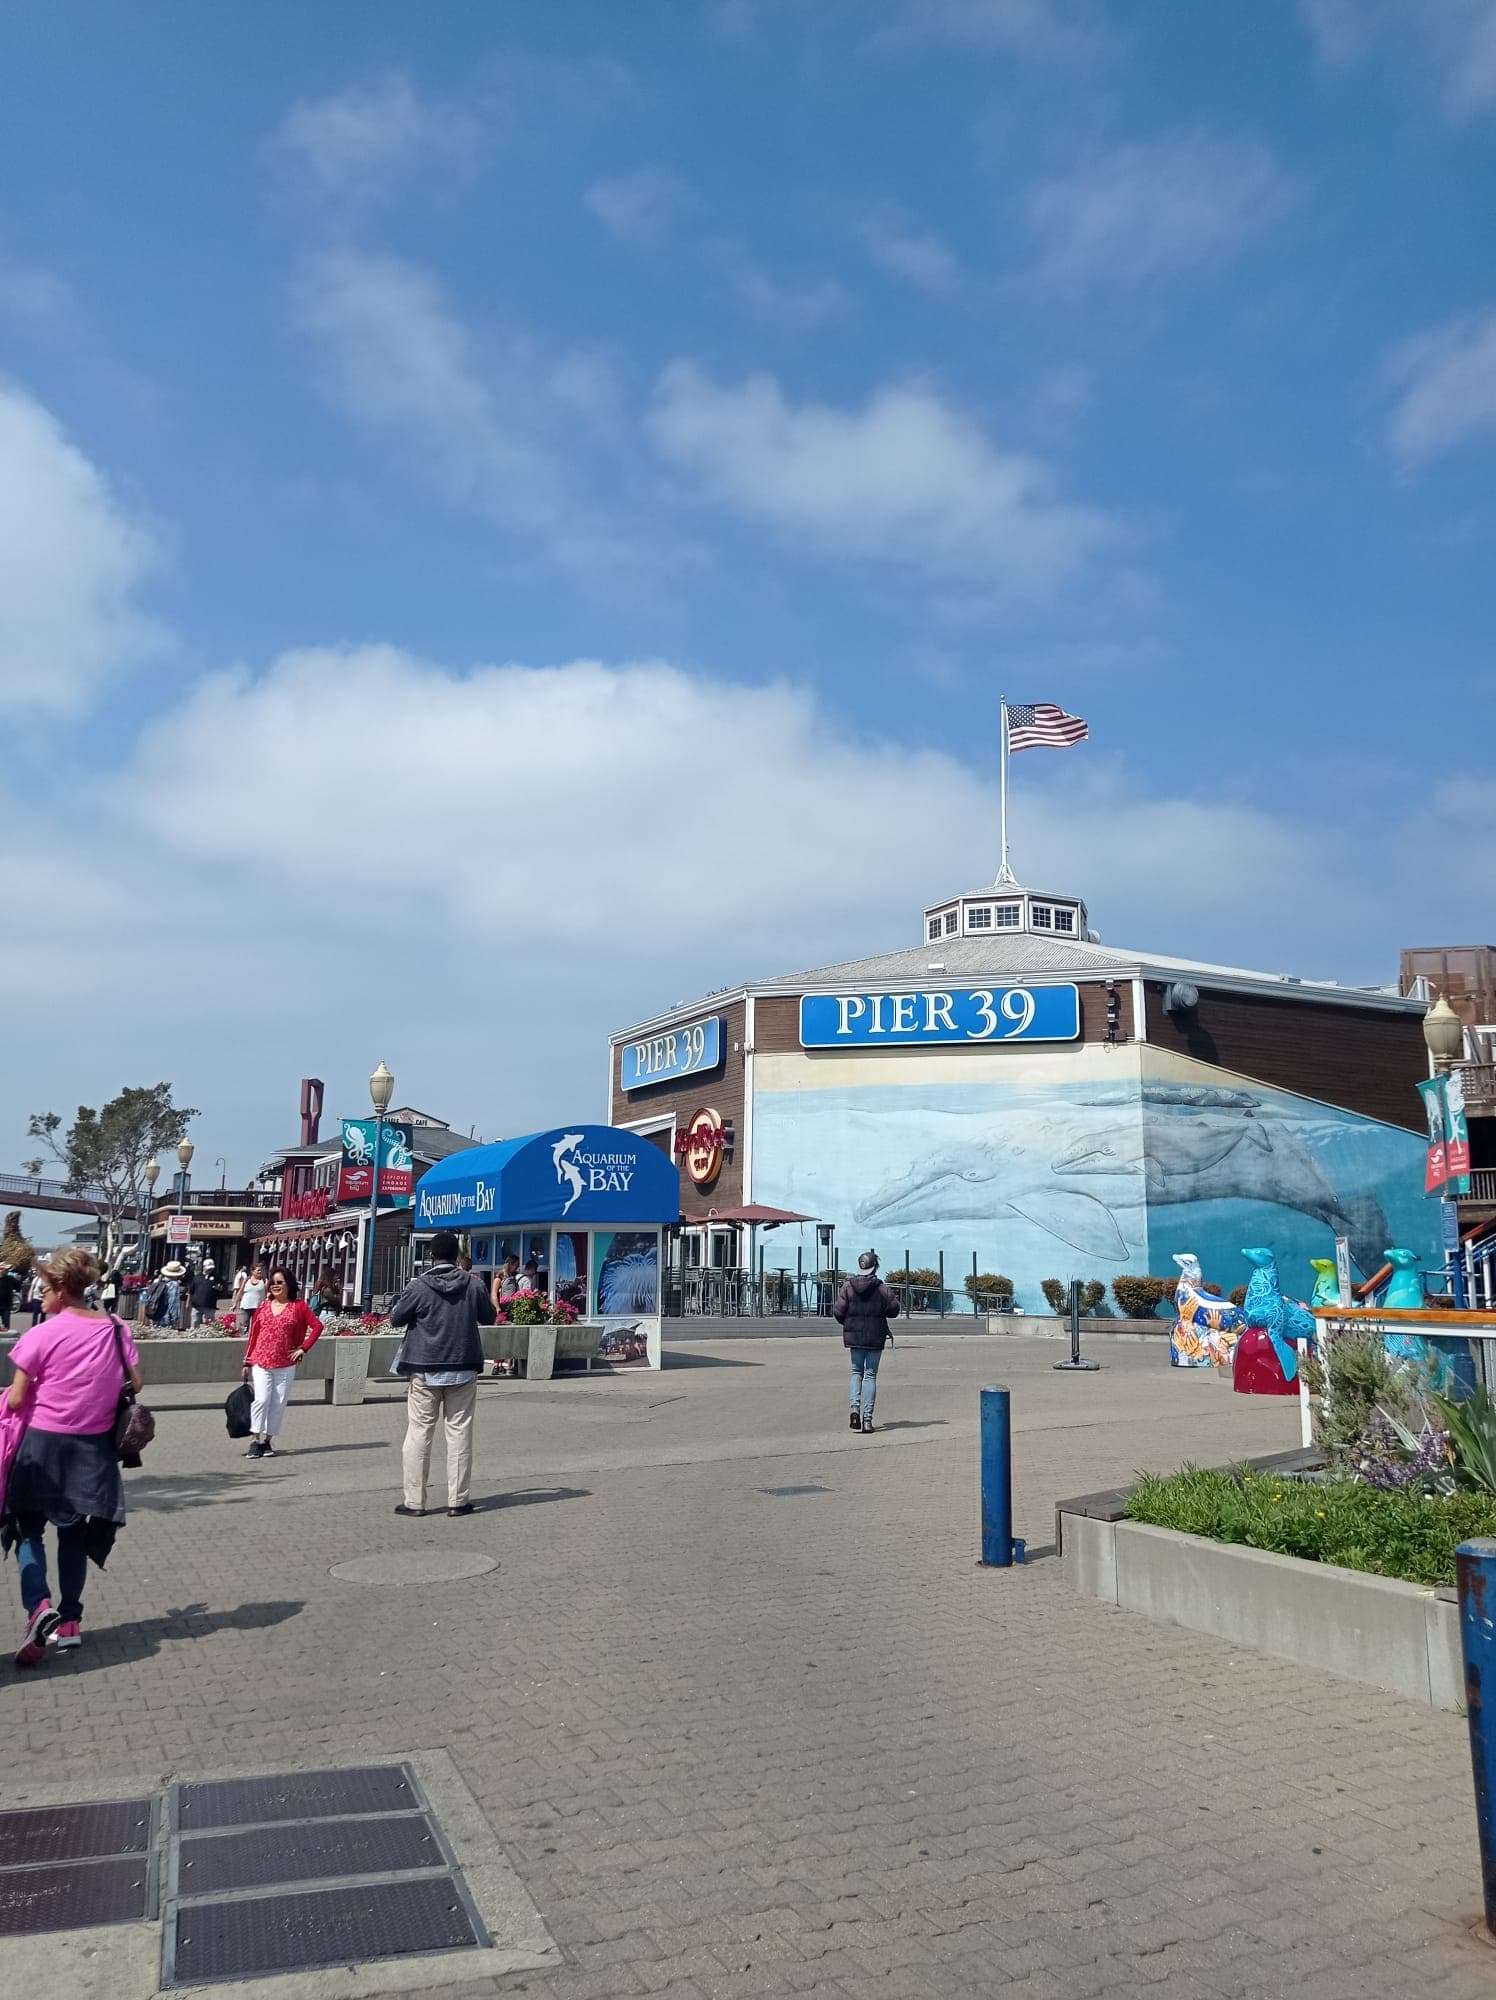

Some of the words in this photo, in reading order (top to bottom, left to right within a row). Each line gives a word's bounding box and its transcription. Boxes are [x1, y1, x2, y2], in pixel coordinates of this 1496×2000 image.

[836, 992, 959, 1034] PIER
[966, 988, 1036, 1039] 39
[635, 1035, 678, 1077] PIER
[681, 1026, 705, 1070] 39
[572, 1149, 637, 1168] AQUARIUM
[588, 1168, 635, 1192] BAY
[419, 1189, 460, 1225] AQUARIUM
[460, 1196, 467, 1208] OF
[467, 1194, 476, 1207] THE
[475, 1181, 496, 1212] BAY
